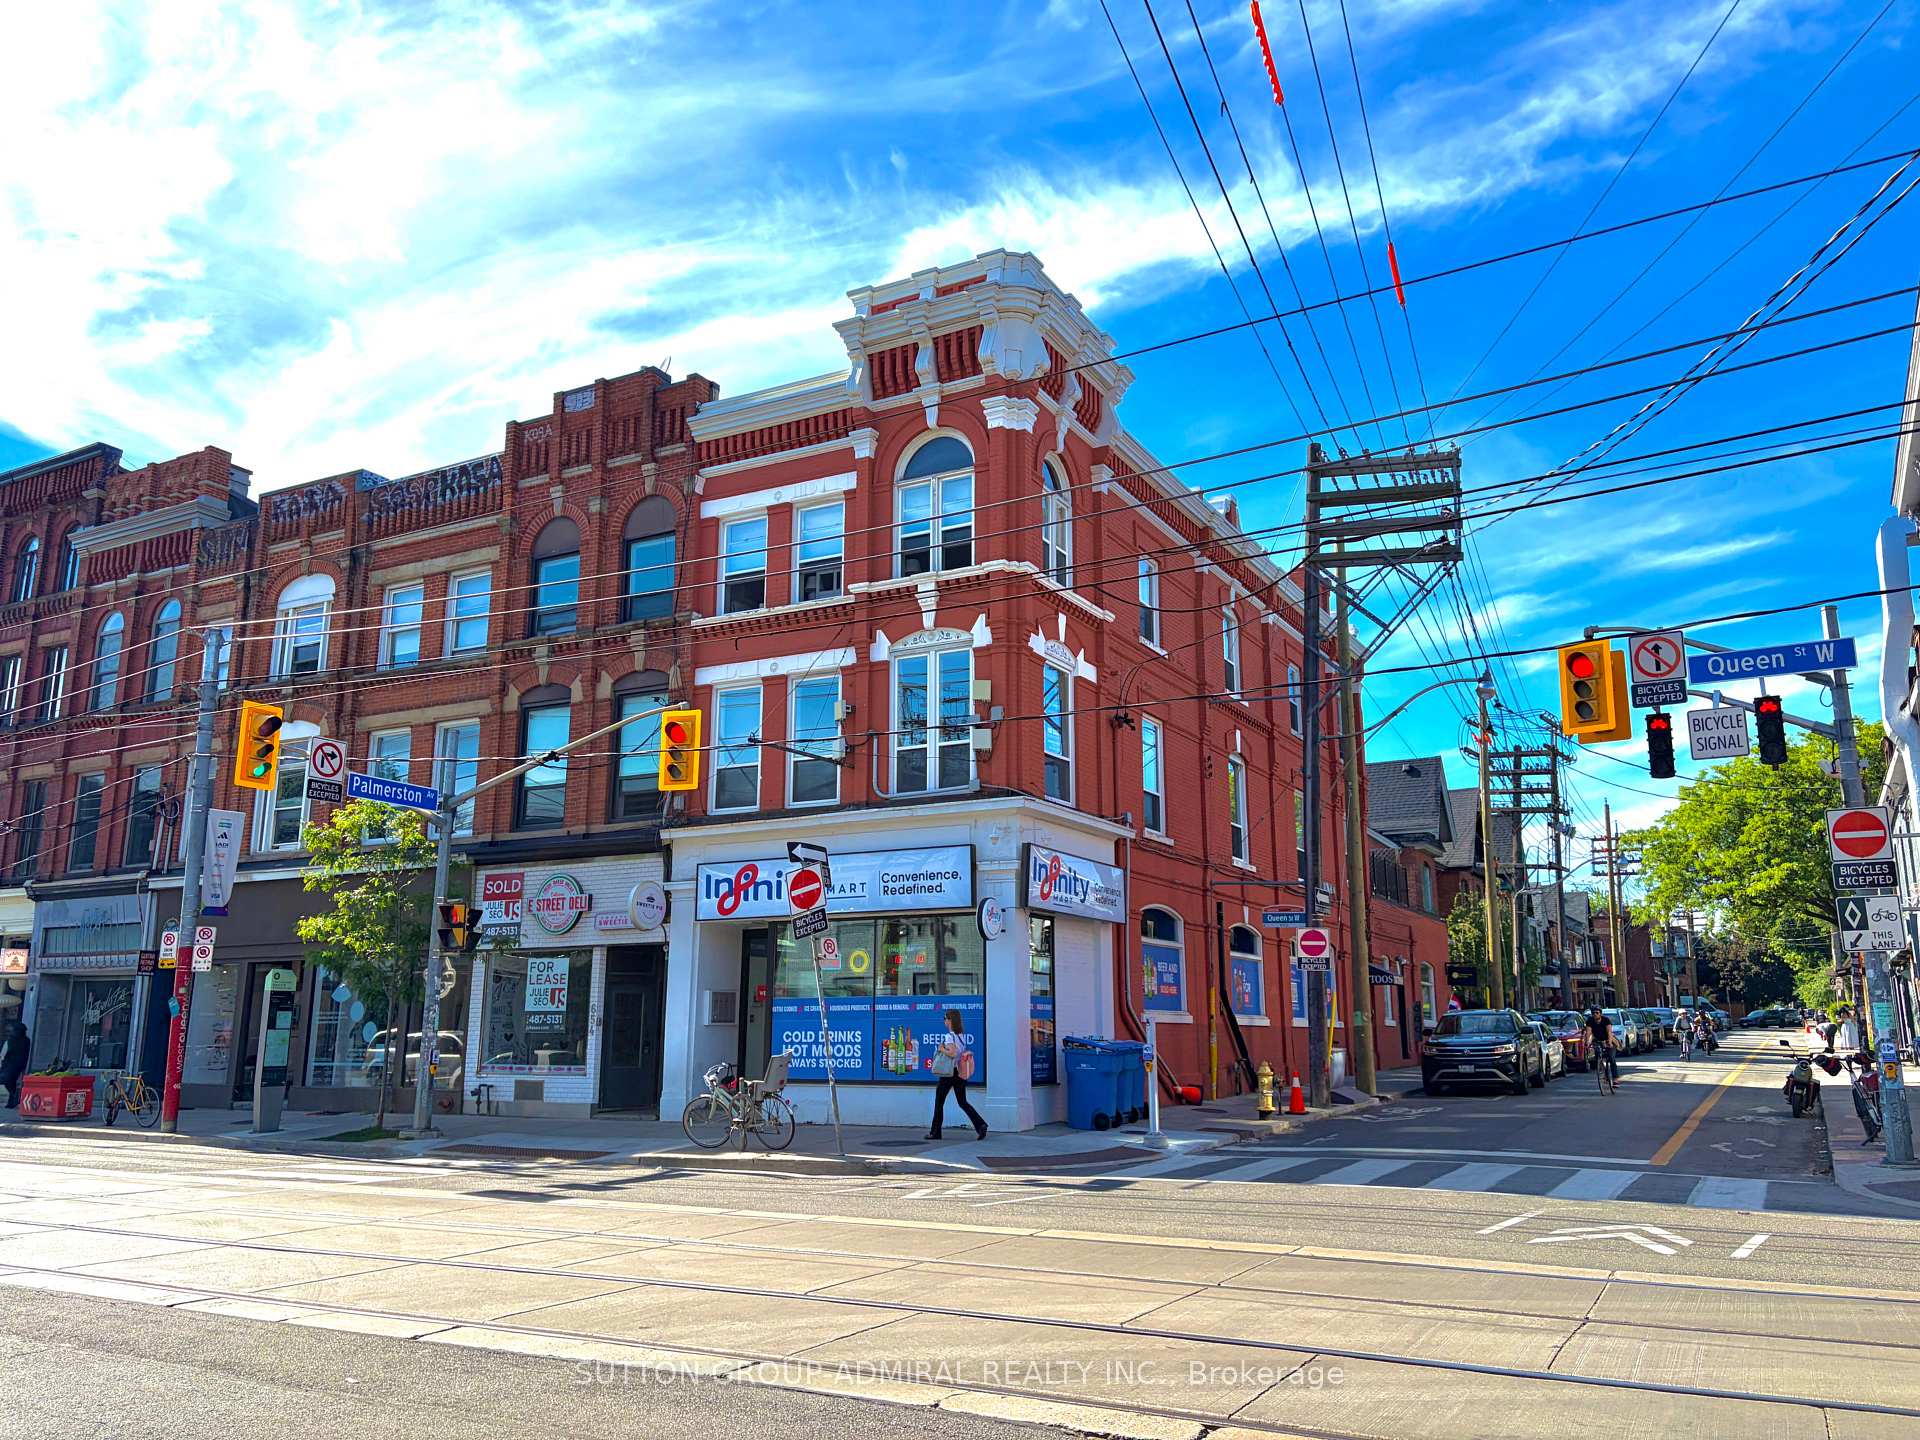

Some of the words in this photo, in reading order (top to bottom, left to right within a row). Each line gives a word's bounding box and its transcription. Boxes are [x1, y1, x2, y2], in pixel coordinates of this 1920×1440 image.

[1708, 653, 1785, 676] Queen
[1794, 646, 1807, 657] St
[1815, 643, 1834, 663] W
[1637, 683, 1680, 695] BICYCLES
[1636, 692, 1684, 705] EXCEPTED
[1693, 714, 1744, 732] BICYCLE
[1697, 734, 1744, 752] SIGNAL
[311, 781, 339, 793] BICYCLES
[352, 776, 422, 803] Palmerston
[427, 790, 434, 799] Av
[308, 790, 340, 801] EXCEPTED
[1840, 864, 1889, 875] BICYCLES
[881, 870, 962, 884] Convenience,
[1838, 875, 1893, 886] EXCEPTED
[485, 880, 521, 894] SOLD
[705, 863, 783, 916] Infini
[826, 882, 867, 894] MART
[883, 882, 946, 896] Redefined.
[536, 897, 566, 912] STREET
[569, 895, 588, 911] DELI
[1053, 895, 1073, 903] MART
[485, 901, 503, 910] JULIE
[489, 910, 503, 919] SEO
[795, 912, 823, 928] BICYCLES
[1267, 914, 1288, 922] Queen
[795, 920, 826, 937] EXCEPTED
[1872, 931, 1893, 939] THIS
[1872, 941, 1897, 949] LANE
[529, 961, 555, 973] FOR
[529, 973, 567, 985] LEASE
[529, 988, 549, 997] JULIE
[533, 998, 549, 1006] SEO
[783, 1031, 815, 1042] COLD
[818, 1031, 862, 1042] DRINKS
[782, 1044, 808, 1057] HOT
[811, 1044, 861, 1057] MOODS
[788, 1058, 817, 1068] WAYS
[818, 1058, 862, 1068] STOCKED
